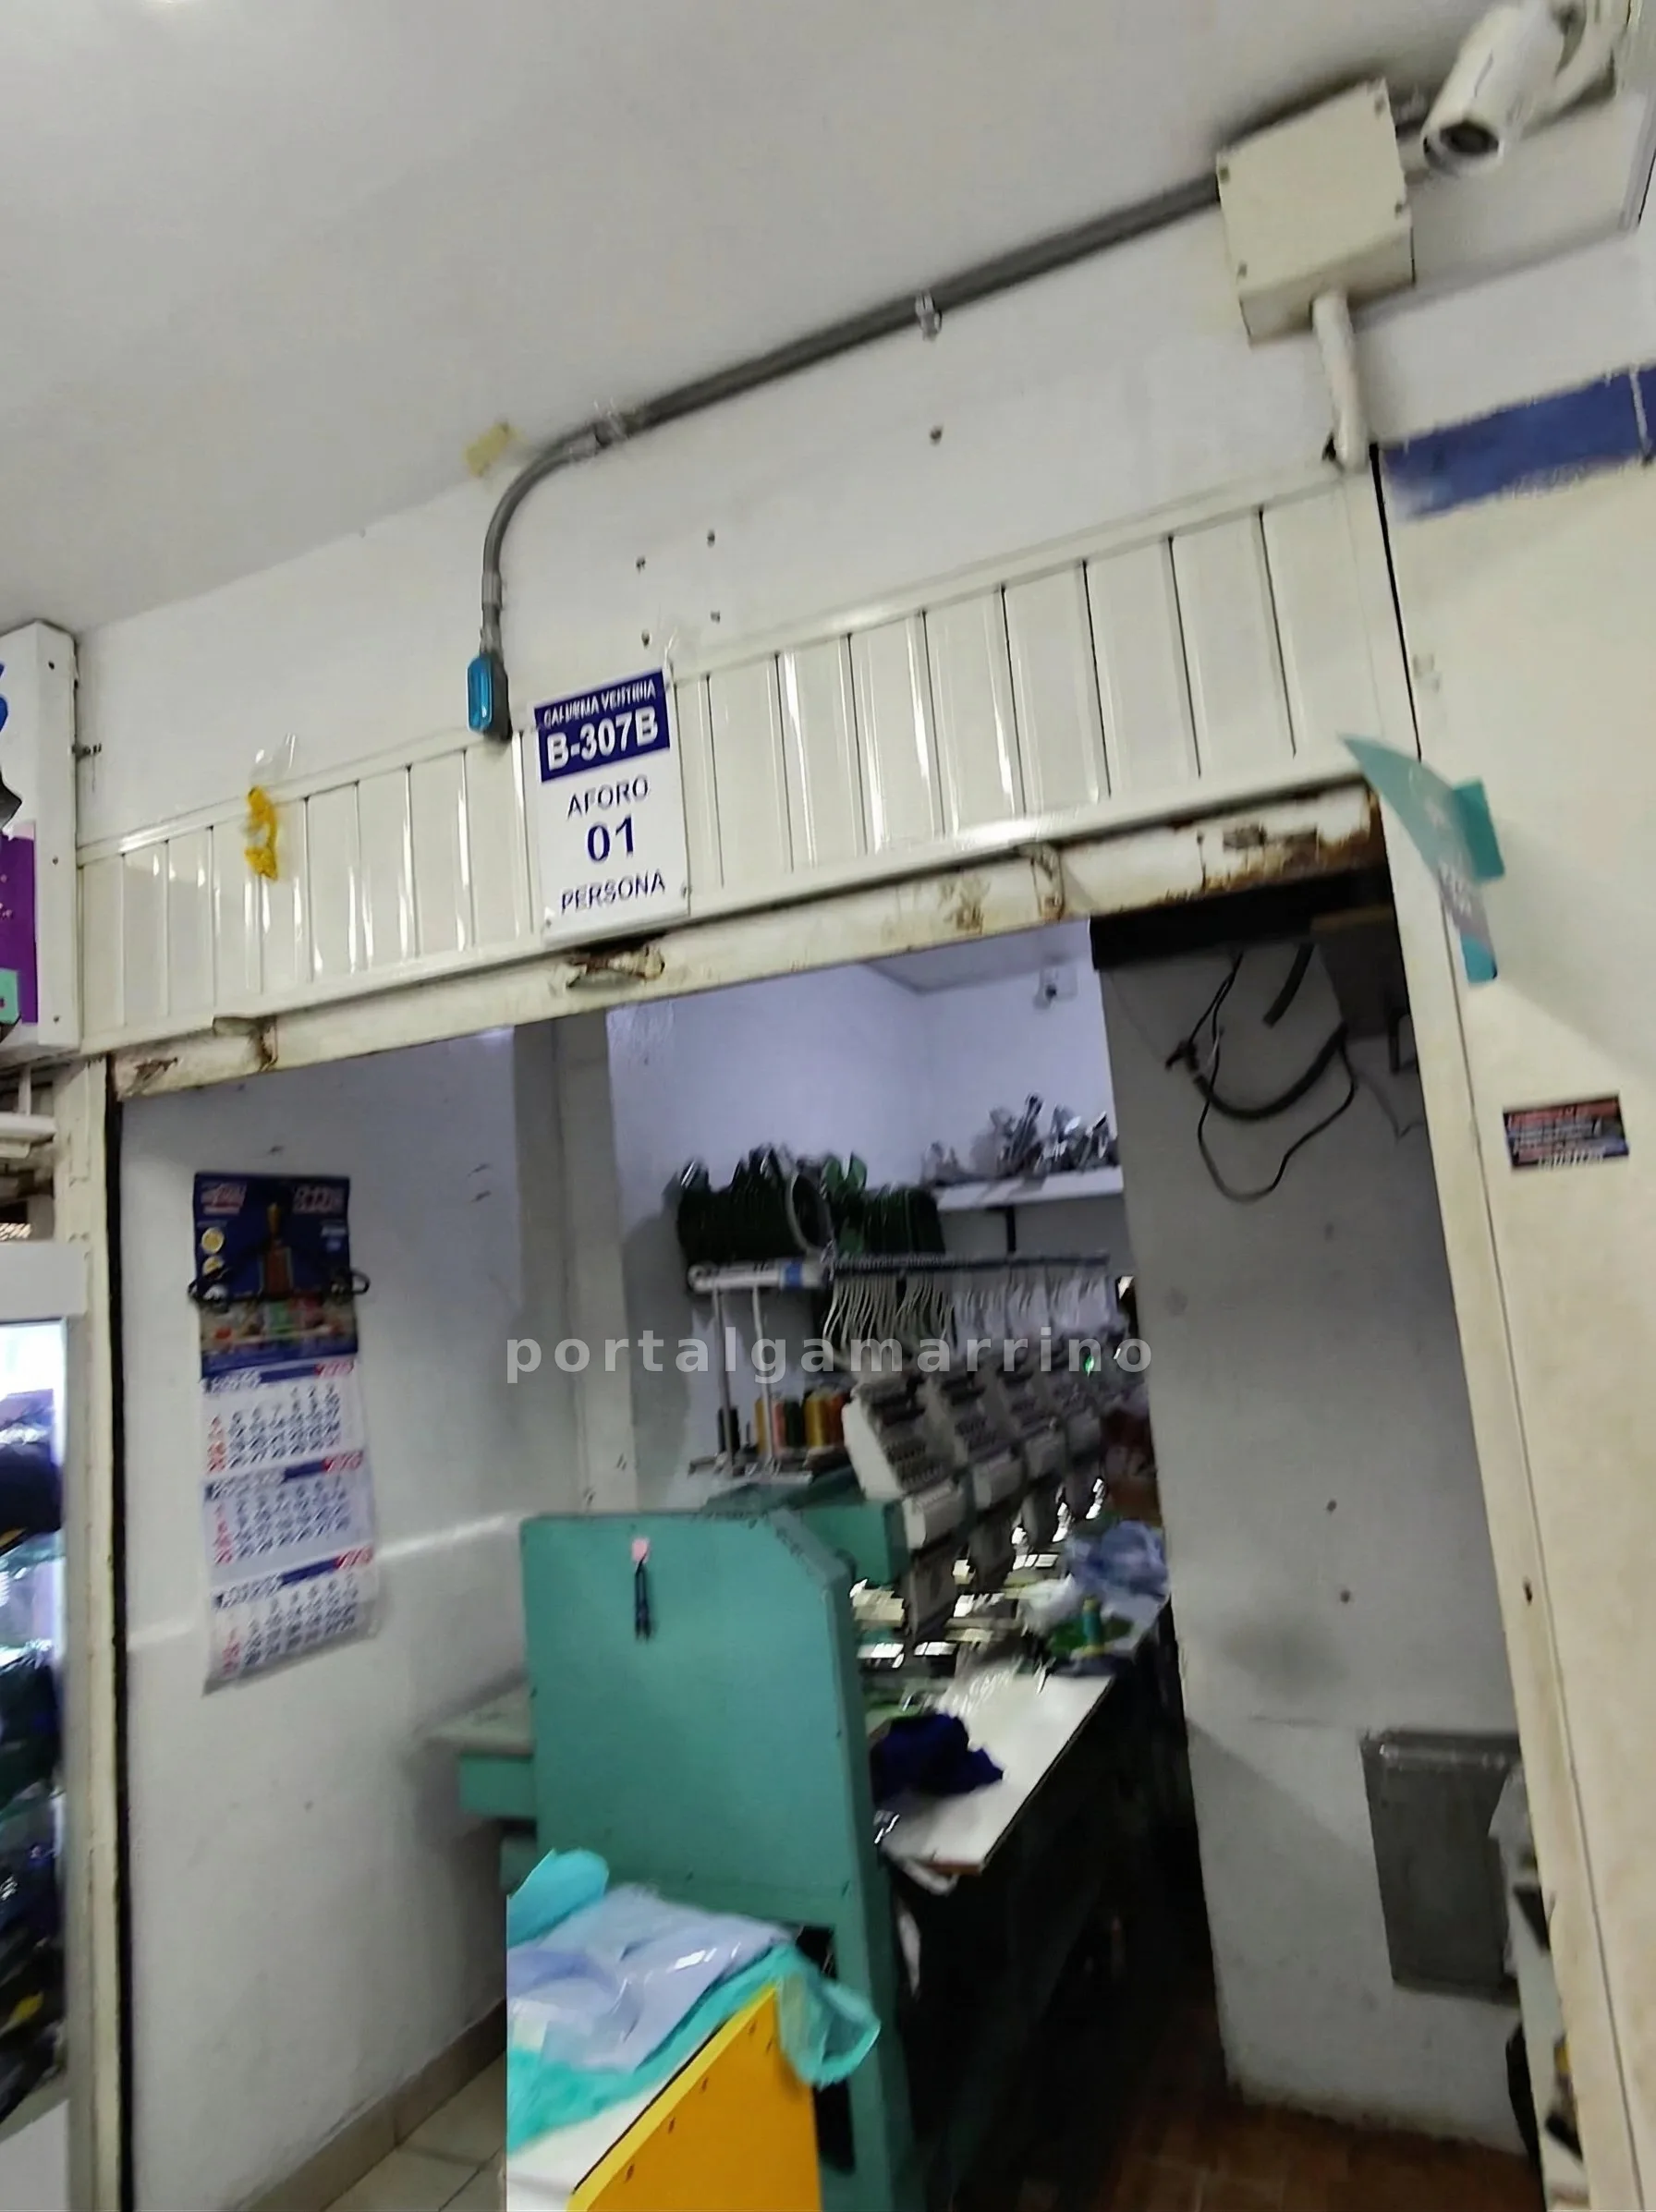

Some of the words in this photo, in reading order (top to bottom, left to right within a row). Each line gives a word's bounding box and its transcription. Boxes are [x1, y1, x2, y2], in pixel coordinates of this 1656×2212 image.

[547, 706, 658, 771] B-307B
[567, 774, 649, 820] AFORO
[587, 813, 634, 863] 01
[561, 869, 665, 915] PERSONA
